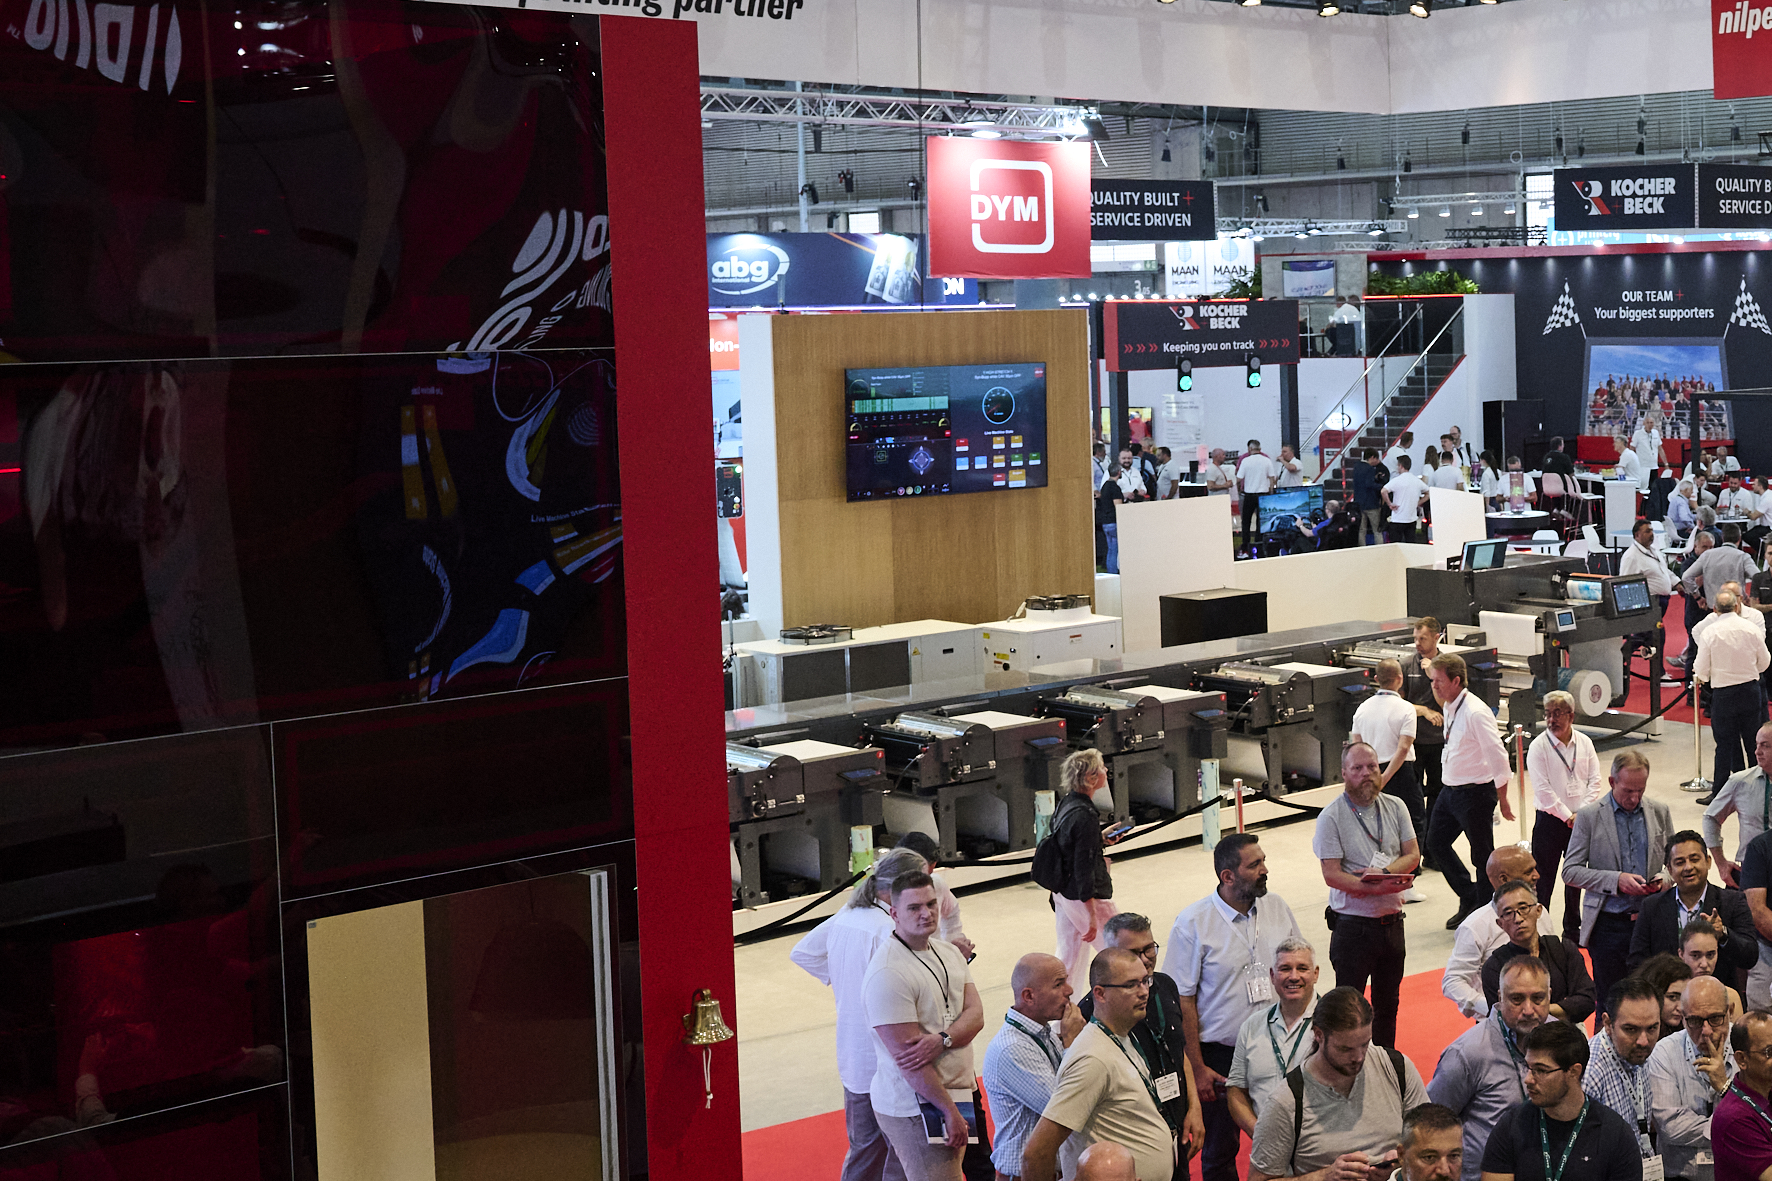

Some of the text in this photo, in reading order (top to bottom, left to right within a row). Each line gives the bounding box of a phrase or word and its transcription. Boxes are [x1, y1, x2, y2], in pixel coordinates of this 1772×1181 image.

[1611, 177, 1676, 197] KOCHER
[1716, 177, 1762, 194] QUALITY
[1144, 192, 1180, 207] BUILT
[1624, 197, 1665, 215] BECK
[1719, 200, 1762, 214] SERVICE
[970, 193, 1039, 222] DYM
[1090, 212, 1192, 227] SERVICE DRIVEN
[711, 255, 769, 283] abg
[1171, 265, 1199, 276] MAAN
[1622, 290, 1673, 302] OUR TEAM
[1200, 305, 1248, 317] KOCHER
[1594, 307, 1714, 322] Your biggest supporters
[1210, 317, 1241, 329] BECK
[1163, 340, 1255, 355] Keeping you on track
